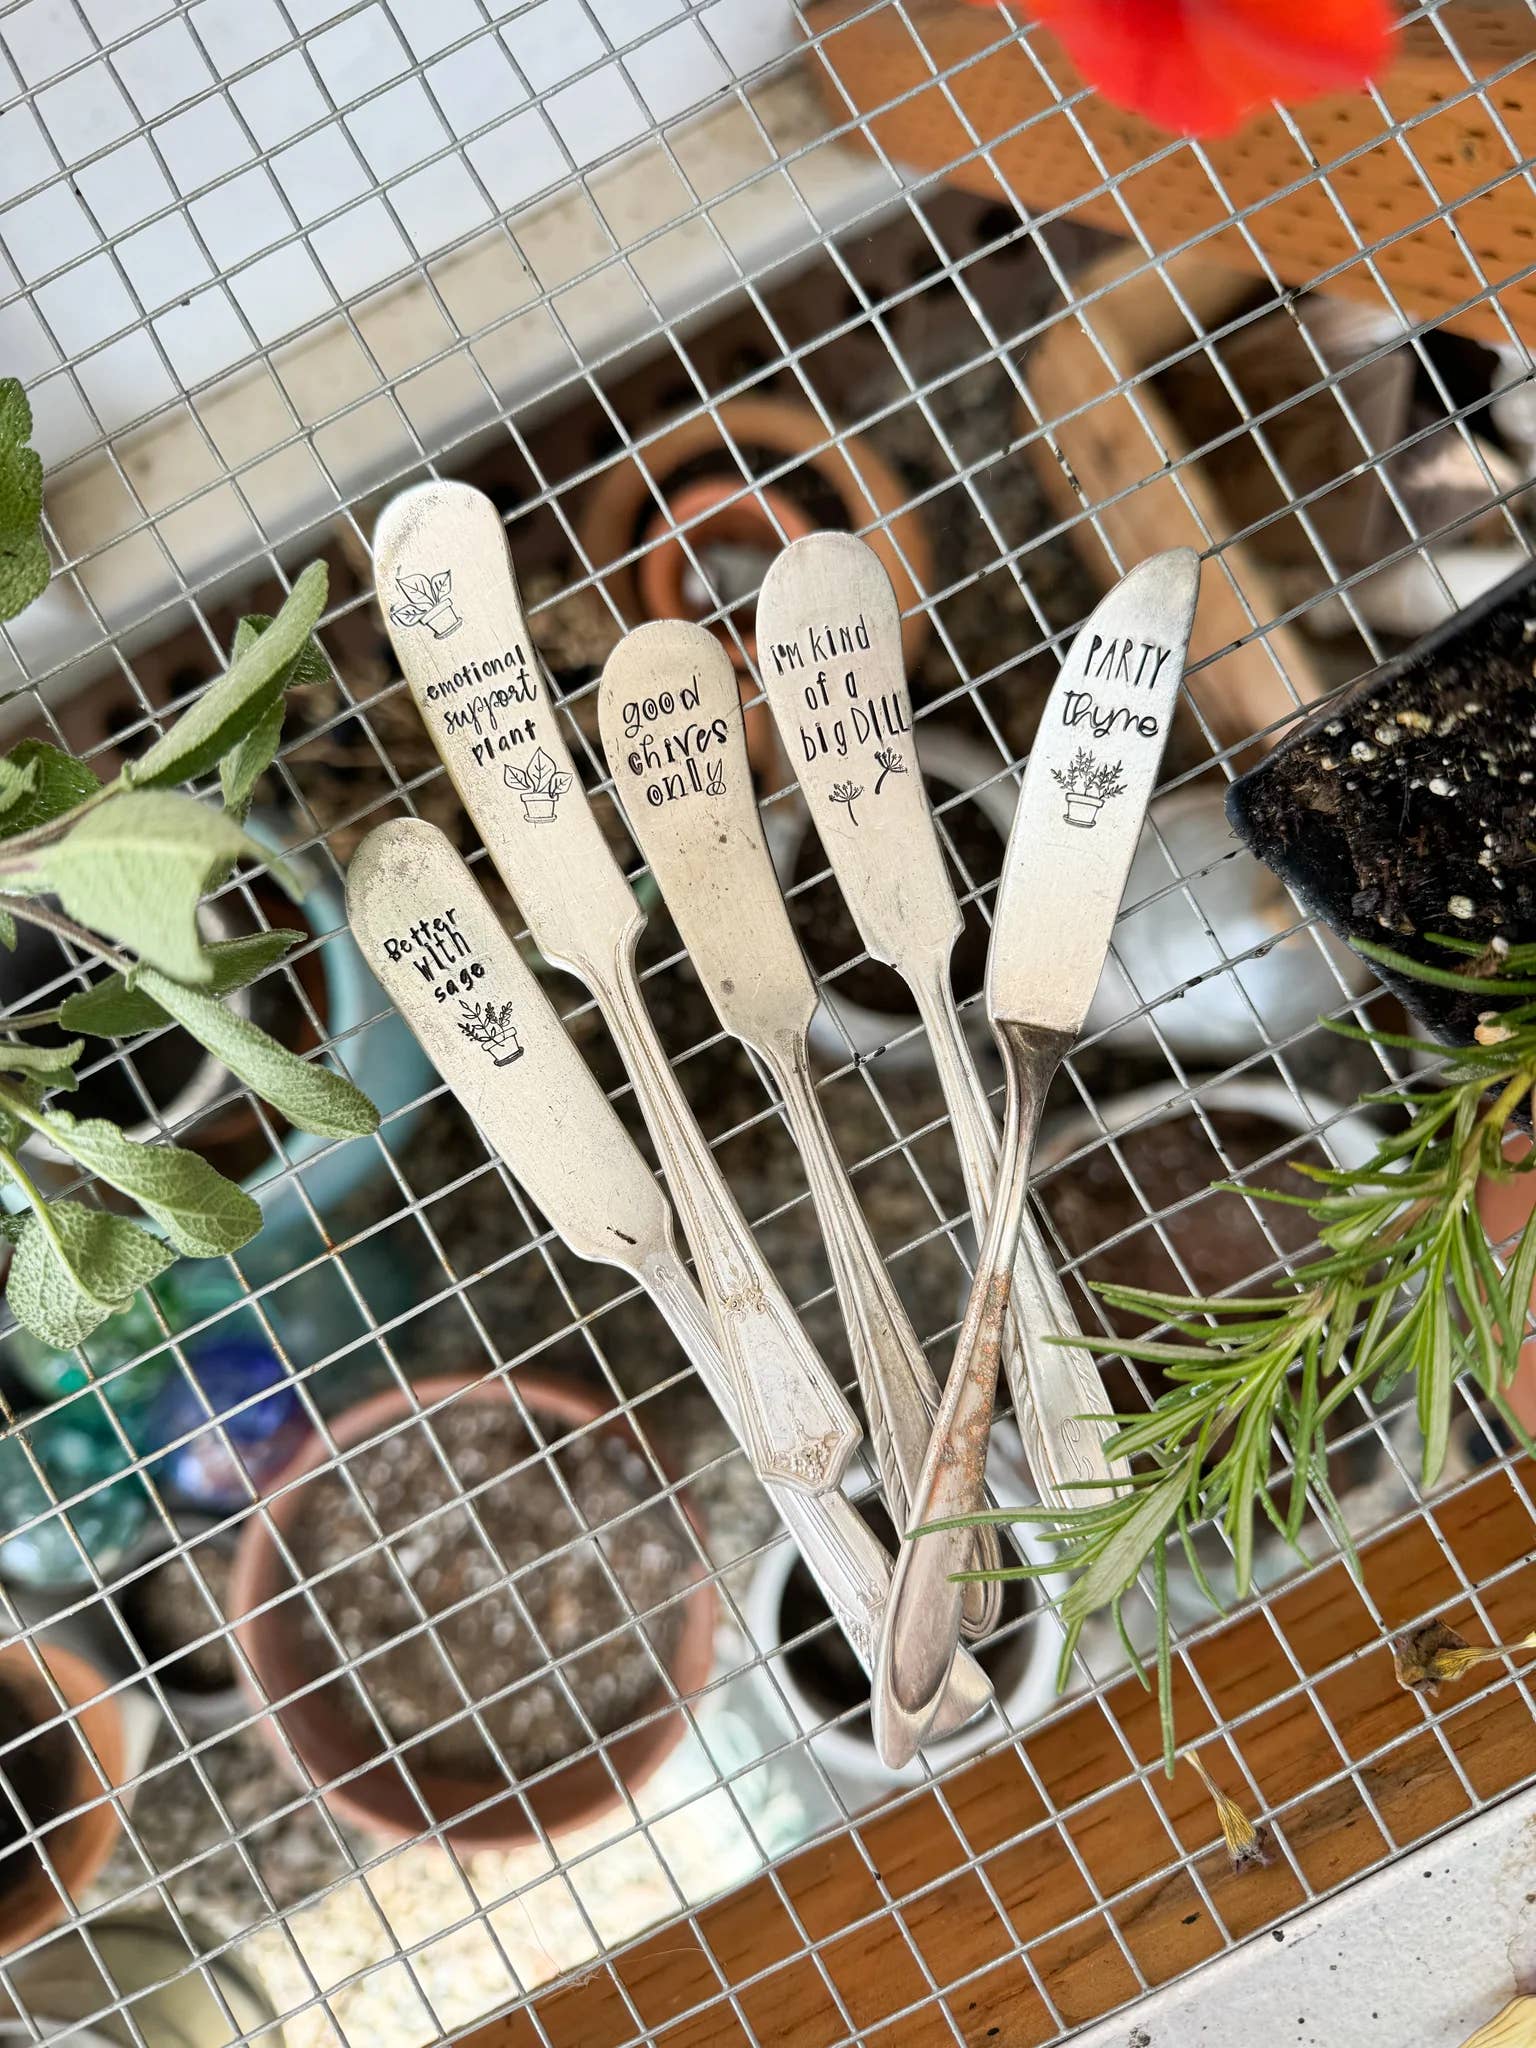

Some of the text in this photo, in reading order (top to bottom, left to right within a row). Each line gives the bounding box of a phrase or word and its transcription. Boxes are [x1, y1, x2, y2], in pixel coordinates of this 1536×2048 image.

[427, 644, 525, 700] emotional
[1084, 634, 1171, 690] PARTY
[444, 668, 537, 735] support
[622, 675, 700, 738] good
[804, 670, 858, 710] of a
[1062, 690, 1159, 738] thyme
[471, 718, 537, 767] plant
[628, 718, 727, 776] chives
[646, 757, 727, 807] only
[383, 908, 456, 962] Better
[413, 922, 472, 982] with
[434, 962, 485, 1004] sage
